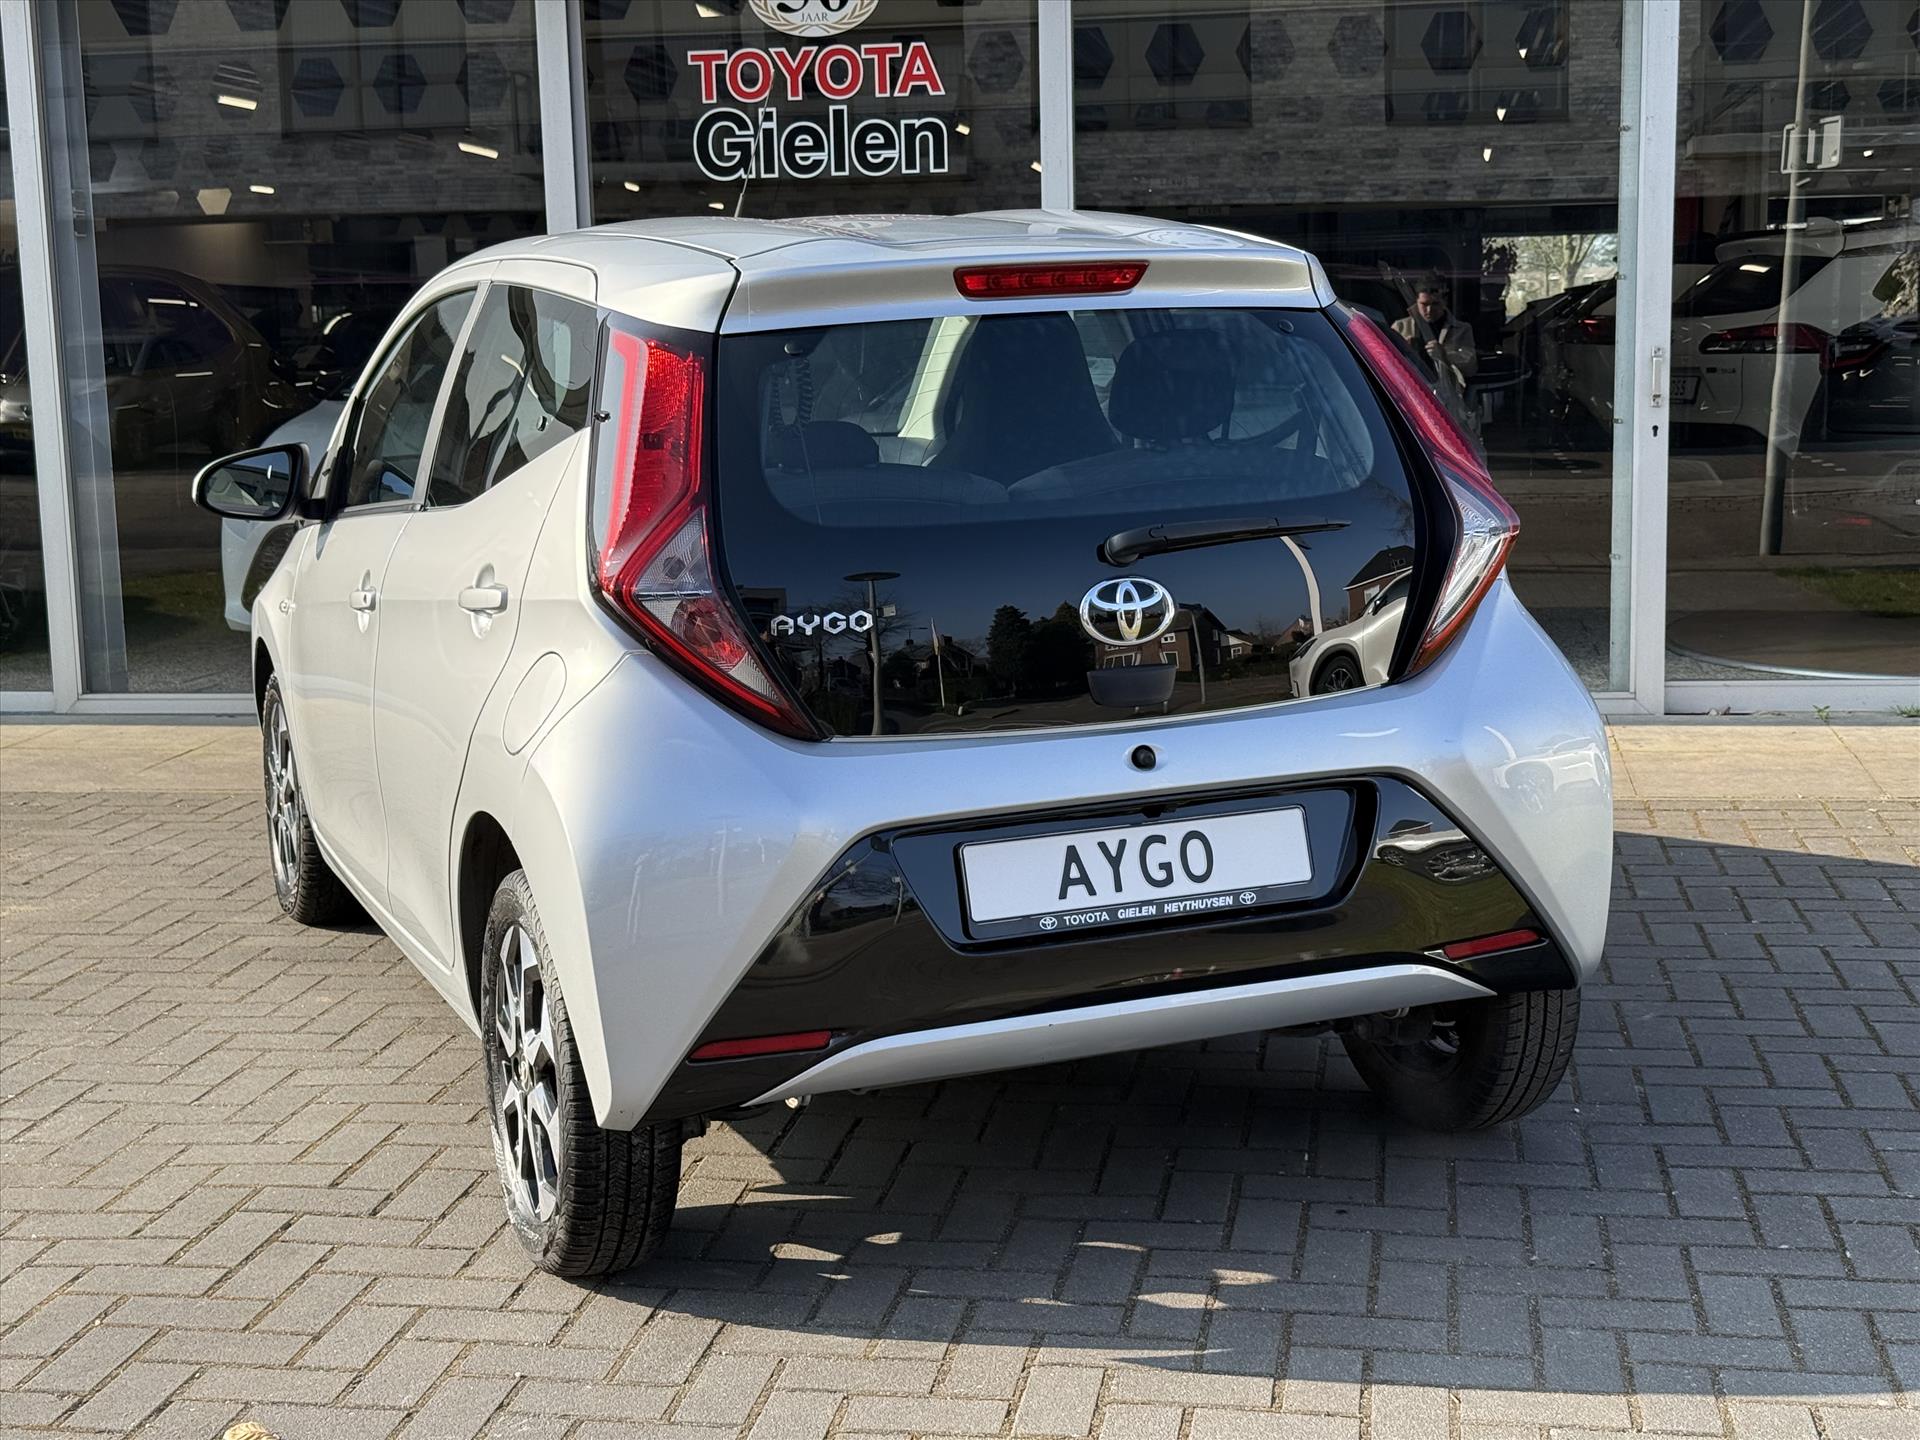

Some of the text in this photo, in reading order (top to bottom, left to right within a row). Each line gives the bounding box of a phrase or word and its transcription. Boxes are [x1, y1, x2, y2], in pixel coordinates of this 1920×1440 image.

[801, 13, 829, 22] JAAR
[687, 42, 946, 104] TOYOTA
[693, 105, 949, 181] Gielen
[770, 610, 874, 636] AYGO
[1058, 830, 1214, 900] AYGO
[1063, 896, 1234, 926] TOYOTA GIELEN HEYTHUYSEN
